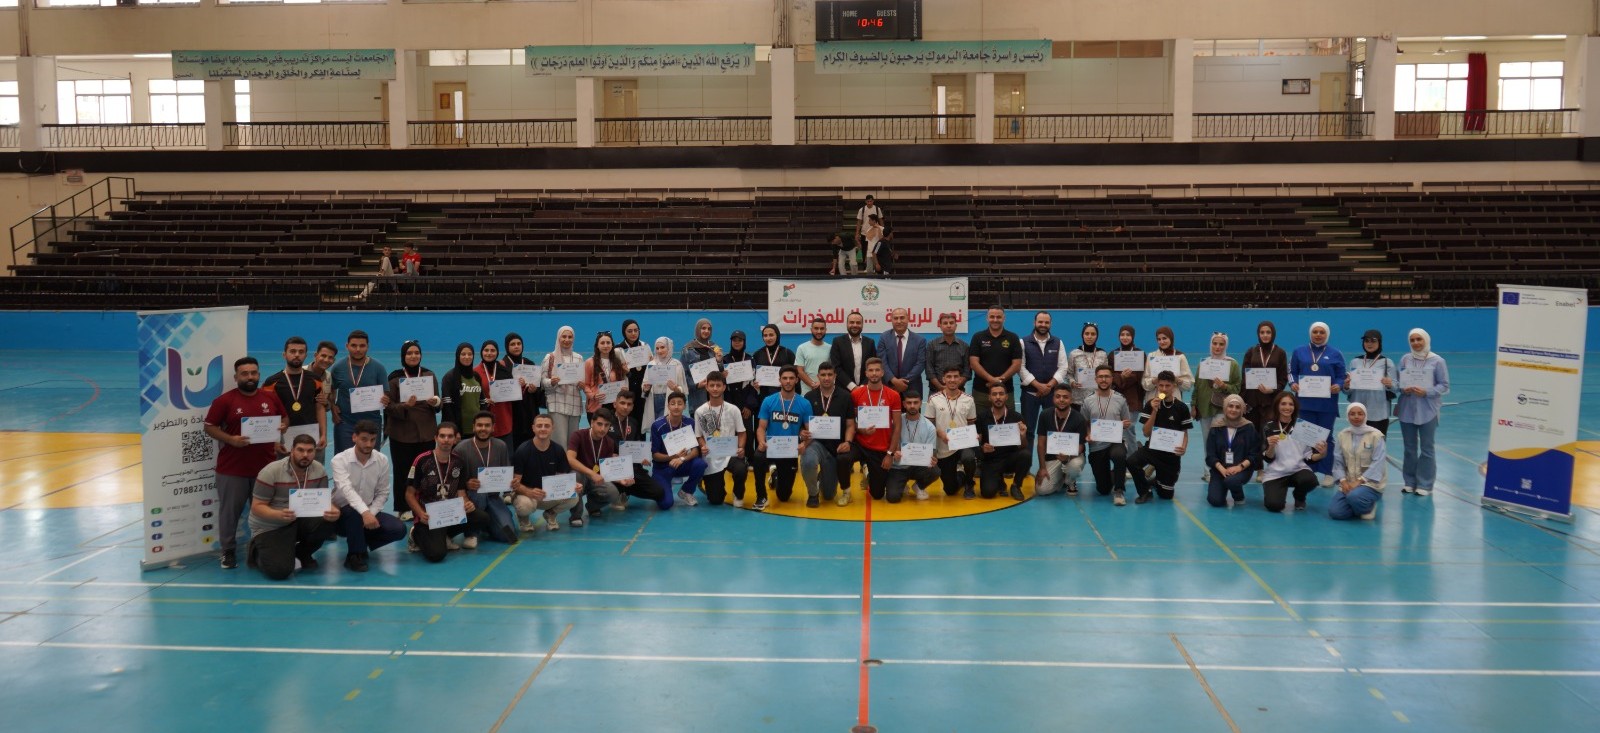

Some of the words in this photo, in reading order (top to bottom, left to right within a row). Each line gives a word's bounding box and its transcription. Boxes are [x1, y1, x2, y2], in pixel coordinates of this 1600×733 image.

[876, 9, 897, 17] GUESTS
[284, 54, 308, 66] تدريب
[310, 54, 330, 65] مراكز
[332, 54, 352, 65] ليست
[354, 54, 389, 65] الجامعات
[541, 56, 568, 71] درجات
[569, 56, 588, 71] العلم
[638, 55, 657, 70] منكم
[681, 54, 704, 70] الذين
[706, 54, 719, 67] الله
[720, 54, 740, 73] يرفع
[823, 49, 848, 68] الكرام
[849, 50, 888, 69] بالضيوف
[890, 49, 924, 65] يرحبون
[925, 49, 961, 65] اليرموك
[963, 49, 990, 64] جامعة
[209, 68, 242, 81] لمستقبلنا
[310, 68, 329, 79] الفكر
[330, 68, 361, 79] لصناعة
[1555, 300, 1576, 308] Enabel
[783, 307, 845, 328] للمخدرات
[885, 307, 932, 328] للرياة
[153, 417, 188, 431] والتطوير
[173, 482, 218, 496] 07882216
